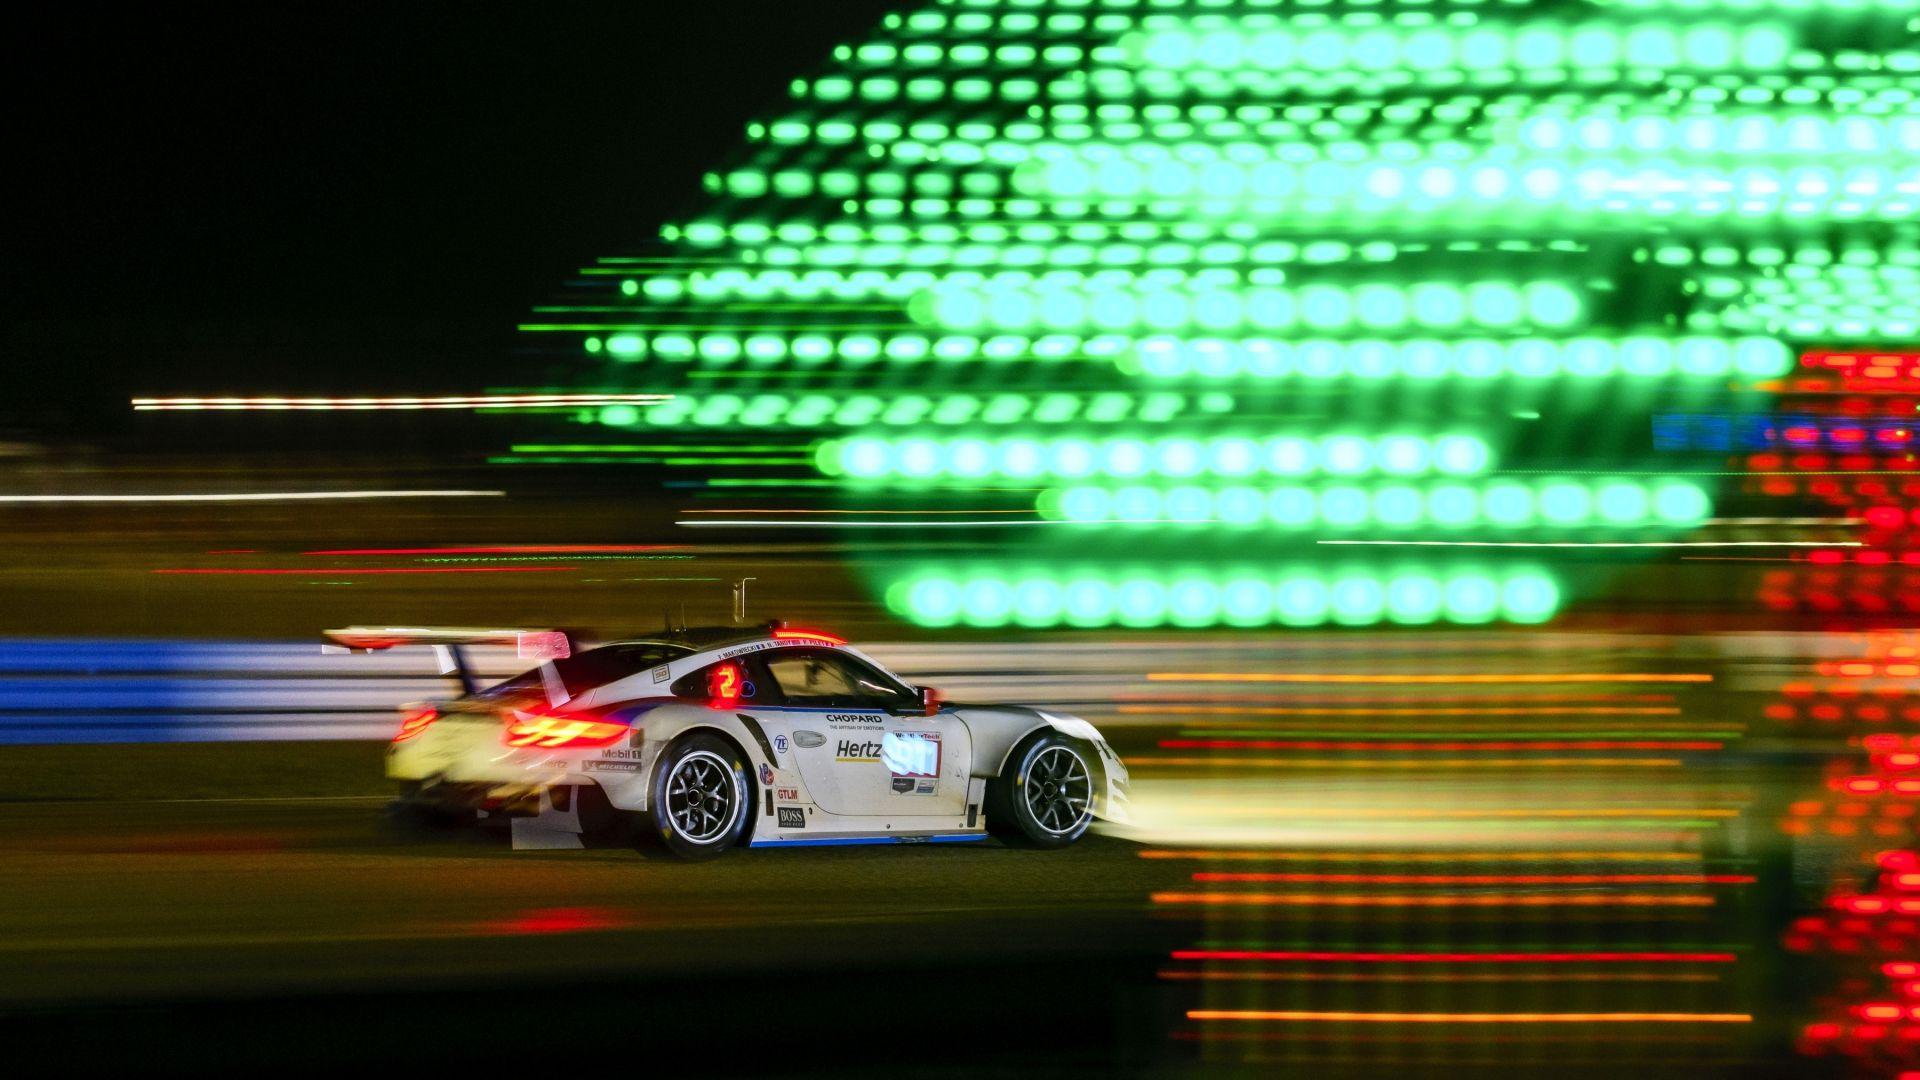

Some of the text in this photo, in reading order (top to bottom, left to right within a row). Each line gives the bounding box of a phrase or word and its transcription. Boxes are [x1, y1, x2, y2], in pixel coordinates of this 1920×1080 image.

[718, 666, 737, 698] 2
[826, 714, 882, 723] CHOPARD
[601, 749, 630, 759] Mobil
[836, 740, 882, 757] Hertz
[778, 789, 798, 800] GTLM
[780, 809, 803, 822] BOSS
